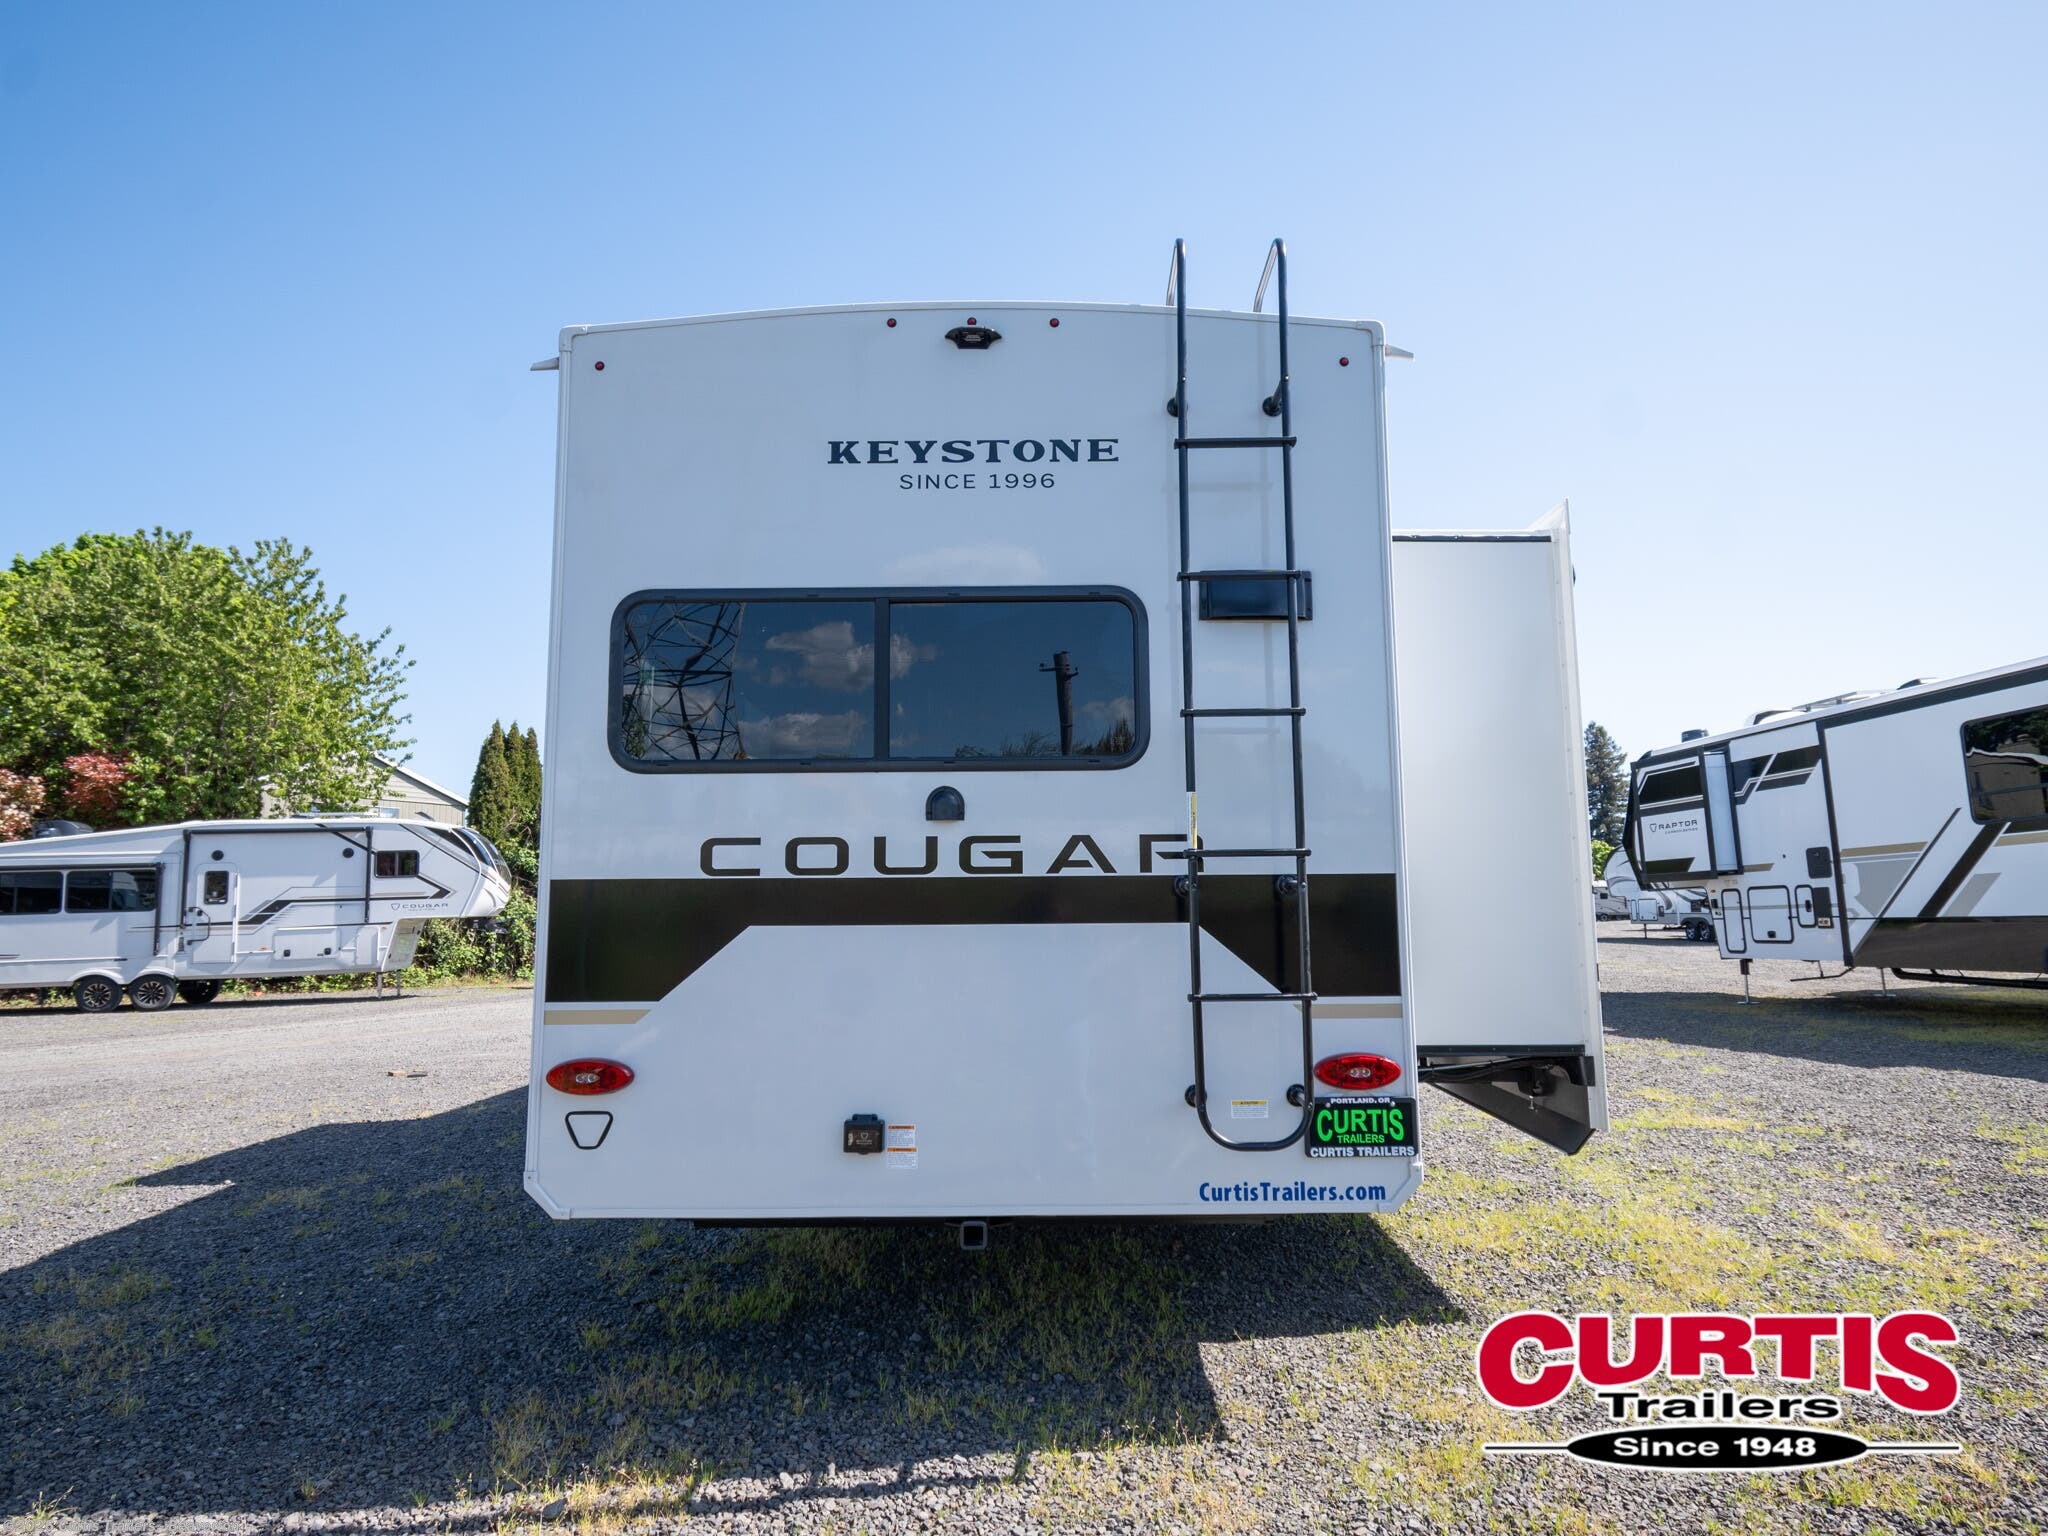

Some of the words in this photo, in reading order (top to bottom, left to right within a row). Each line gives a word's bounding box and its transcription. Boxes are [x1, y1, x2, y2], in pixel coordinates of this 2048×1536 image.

[827, 438, 1119, 464] KEYSTONE
[899, 473, 976, 489] SINCE
[989, 473, 1055, 489] 1996
[1658, 819, 1698, 830] RAPTOR
[700, 834, 1204, 876] COUGAR
[1317, 1108, 1405, 1142] CURTIS
[1337, 1134, 1385, 1144] TRAILERS
[1310, 1147, 1354, 1158] CURTIS
[1357, 1146, 1415, 1157] TRAILERS
[1200, 1182, 1386, 1202] CurtisTrailers.com
